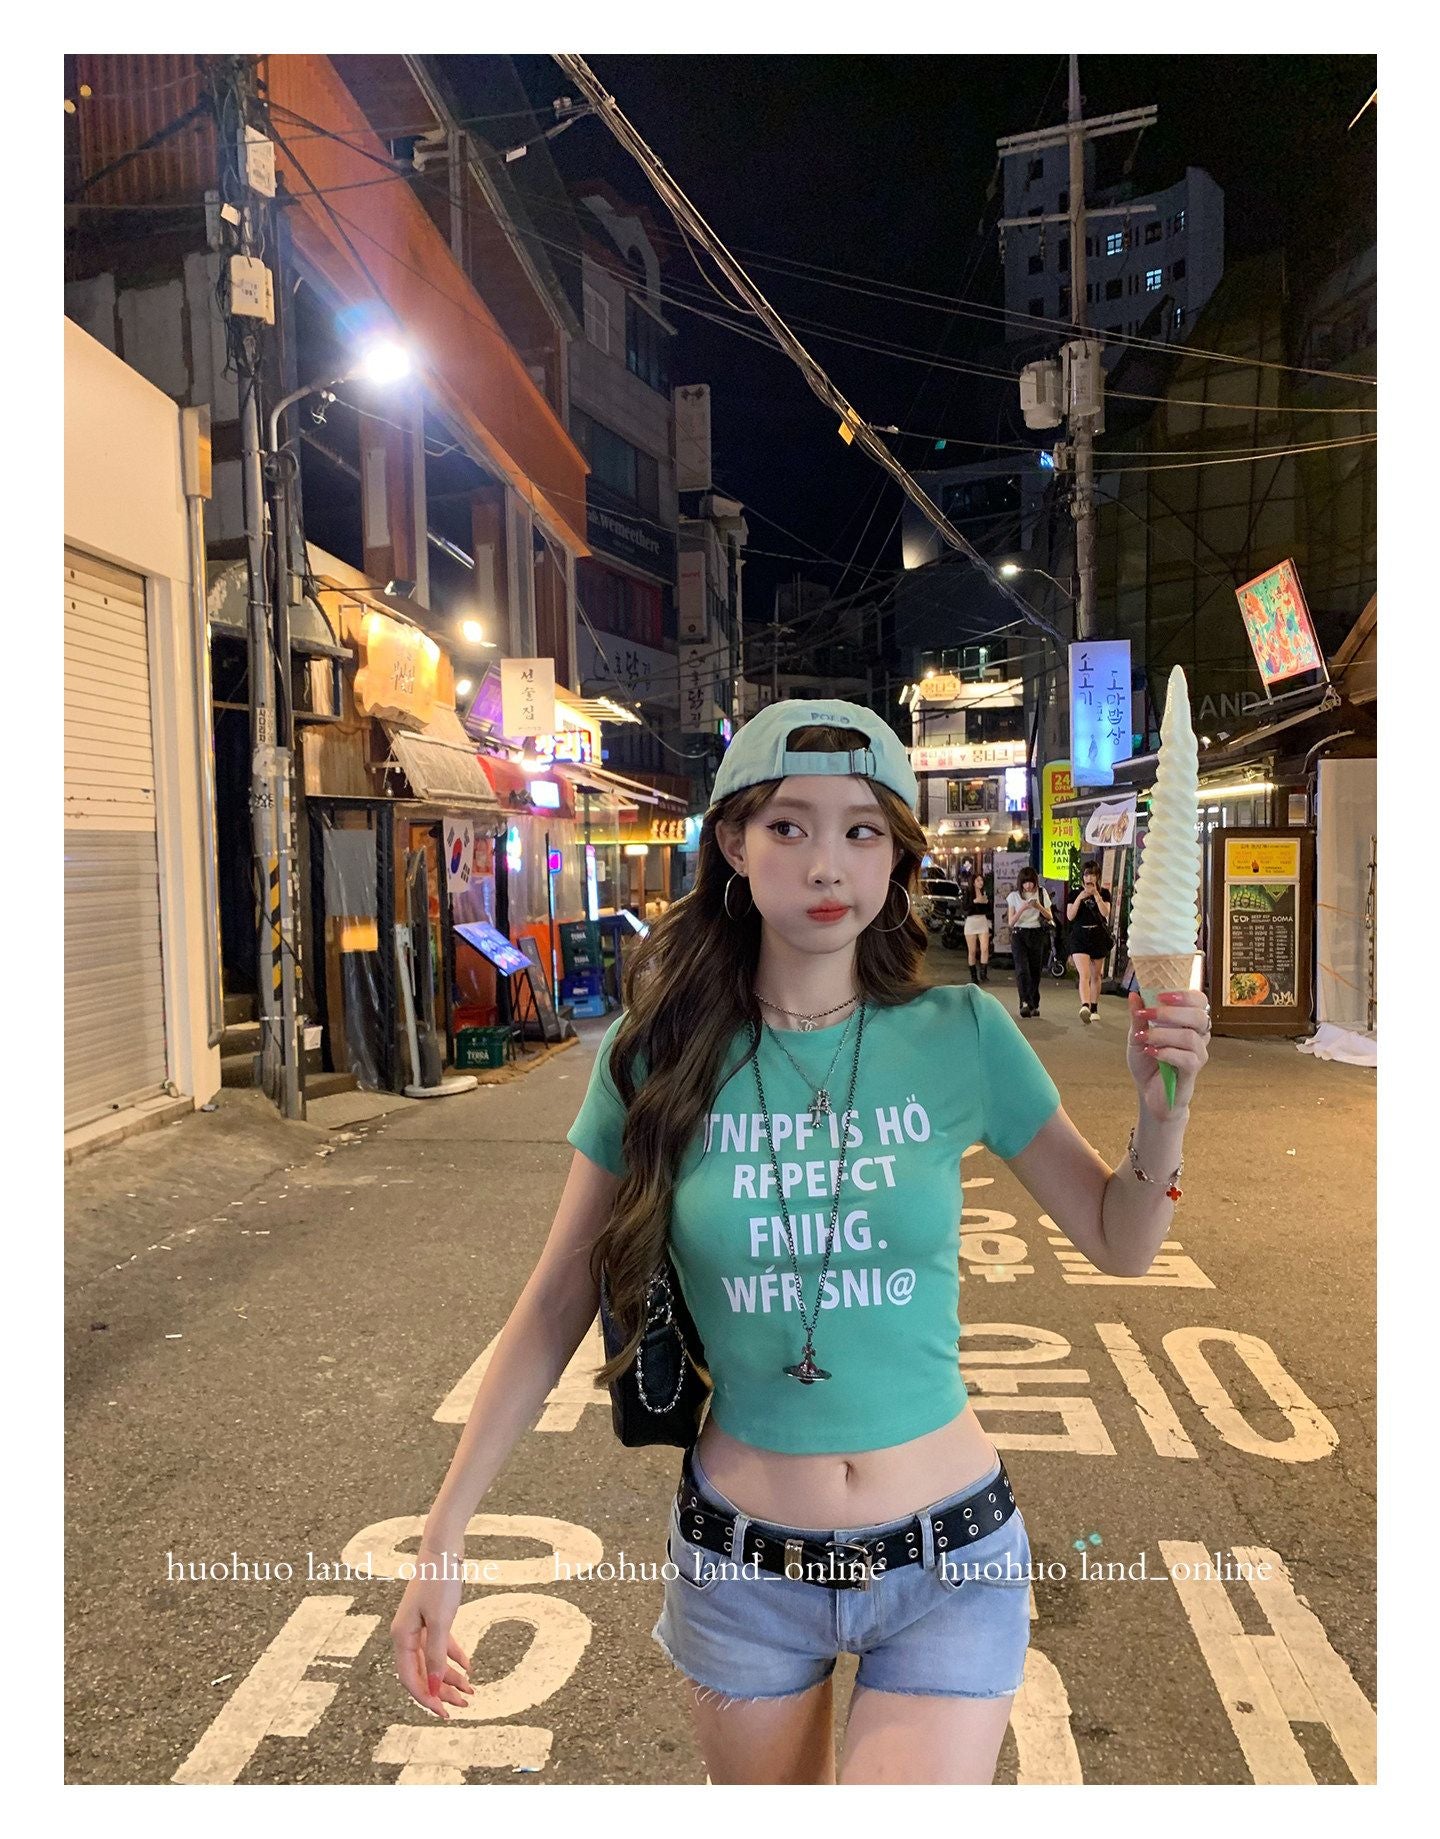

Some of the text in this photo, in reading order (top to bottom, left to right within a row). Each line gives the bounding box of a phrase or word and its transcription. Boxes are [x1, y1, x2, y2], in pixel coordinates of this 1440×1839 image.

[1078, 652, 1094, 706] 소고기
[520, 668, 536, 720] 선술집
[1054, 775, 1071, 785] 24
[1052, 826, 1073, 837] 카페
[1051, 840, 1075, 849] HONG
[1052, 856, 1069, 864] JAN
[1272, 915, 1294, 923] DOMA
[828, 1109, 864, 1150] IS
[818, 1267, 917, 1311] SNI@
